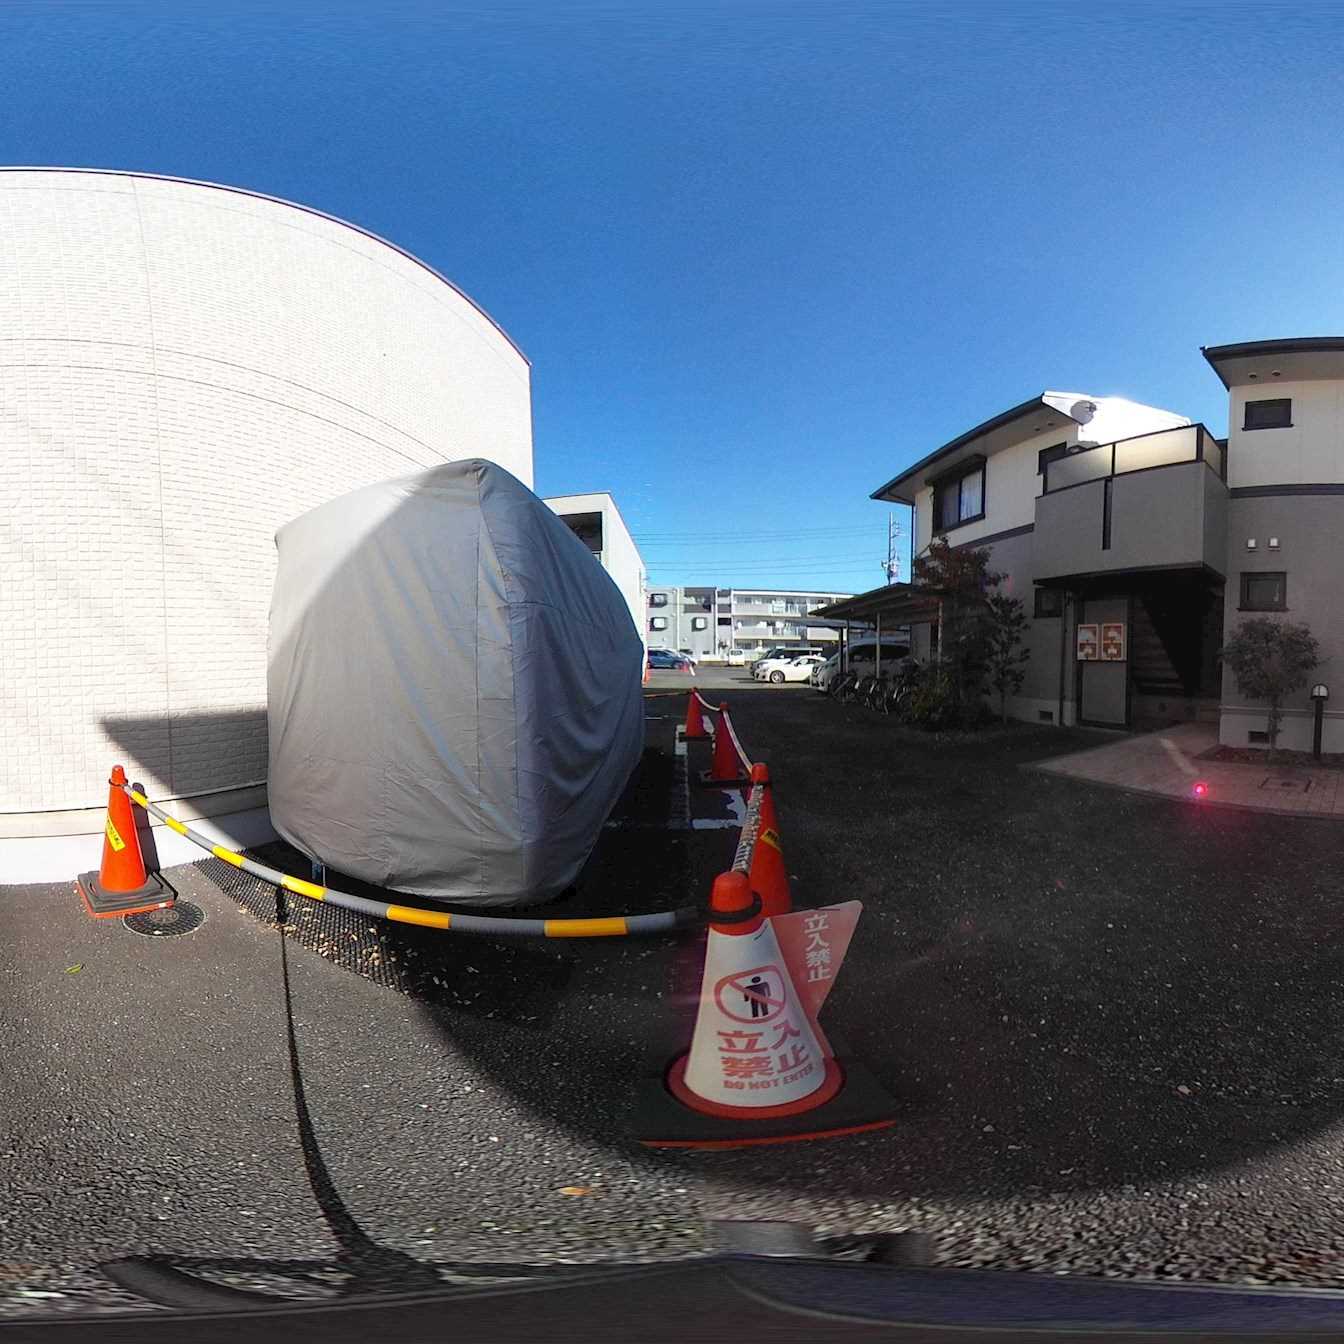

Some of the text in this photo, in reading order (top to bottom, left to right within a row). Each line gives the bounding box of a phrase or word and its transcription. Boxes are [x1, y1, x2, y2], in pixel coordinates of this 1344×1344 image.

[804, 912, 832, 983] 立入禁止
[717, 1021, 801, 1054] 立入
[720, 1044, 809, 1079] 禁止
[723, 1063, 814, 1090] DO NOT ENTER
